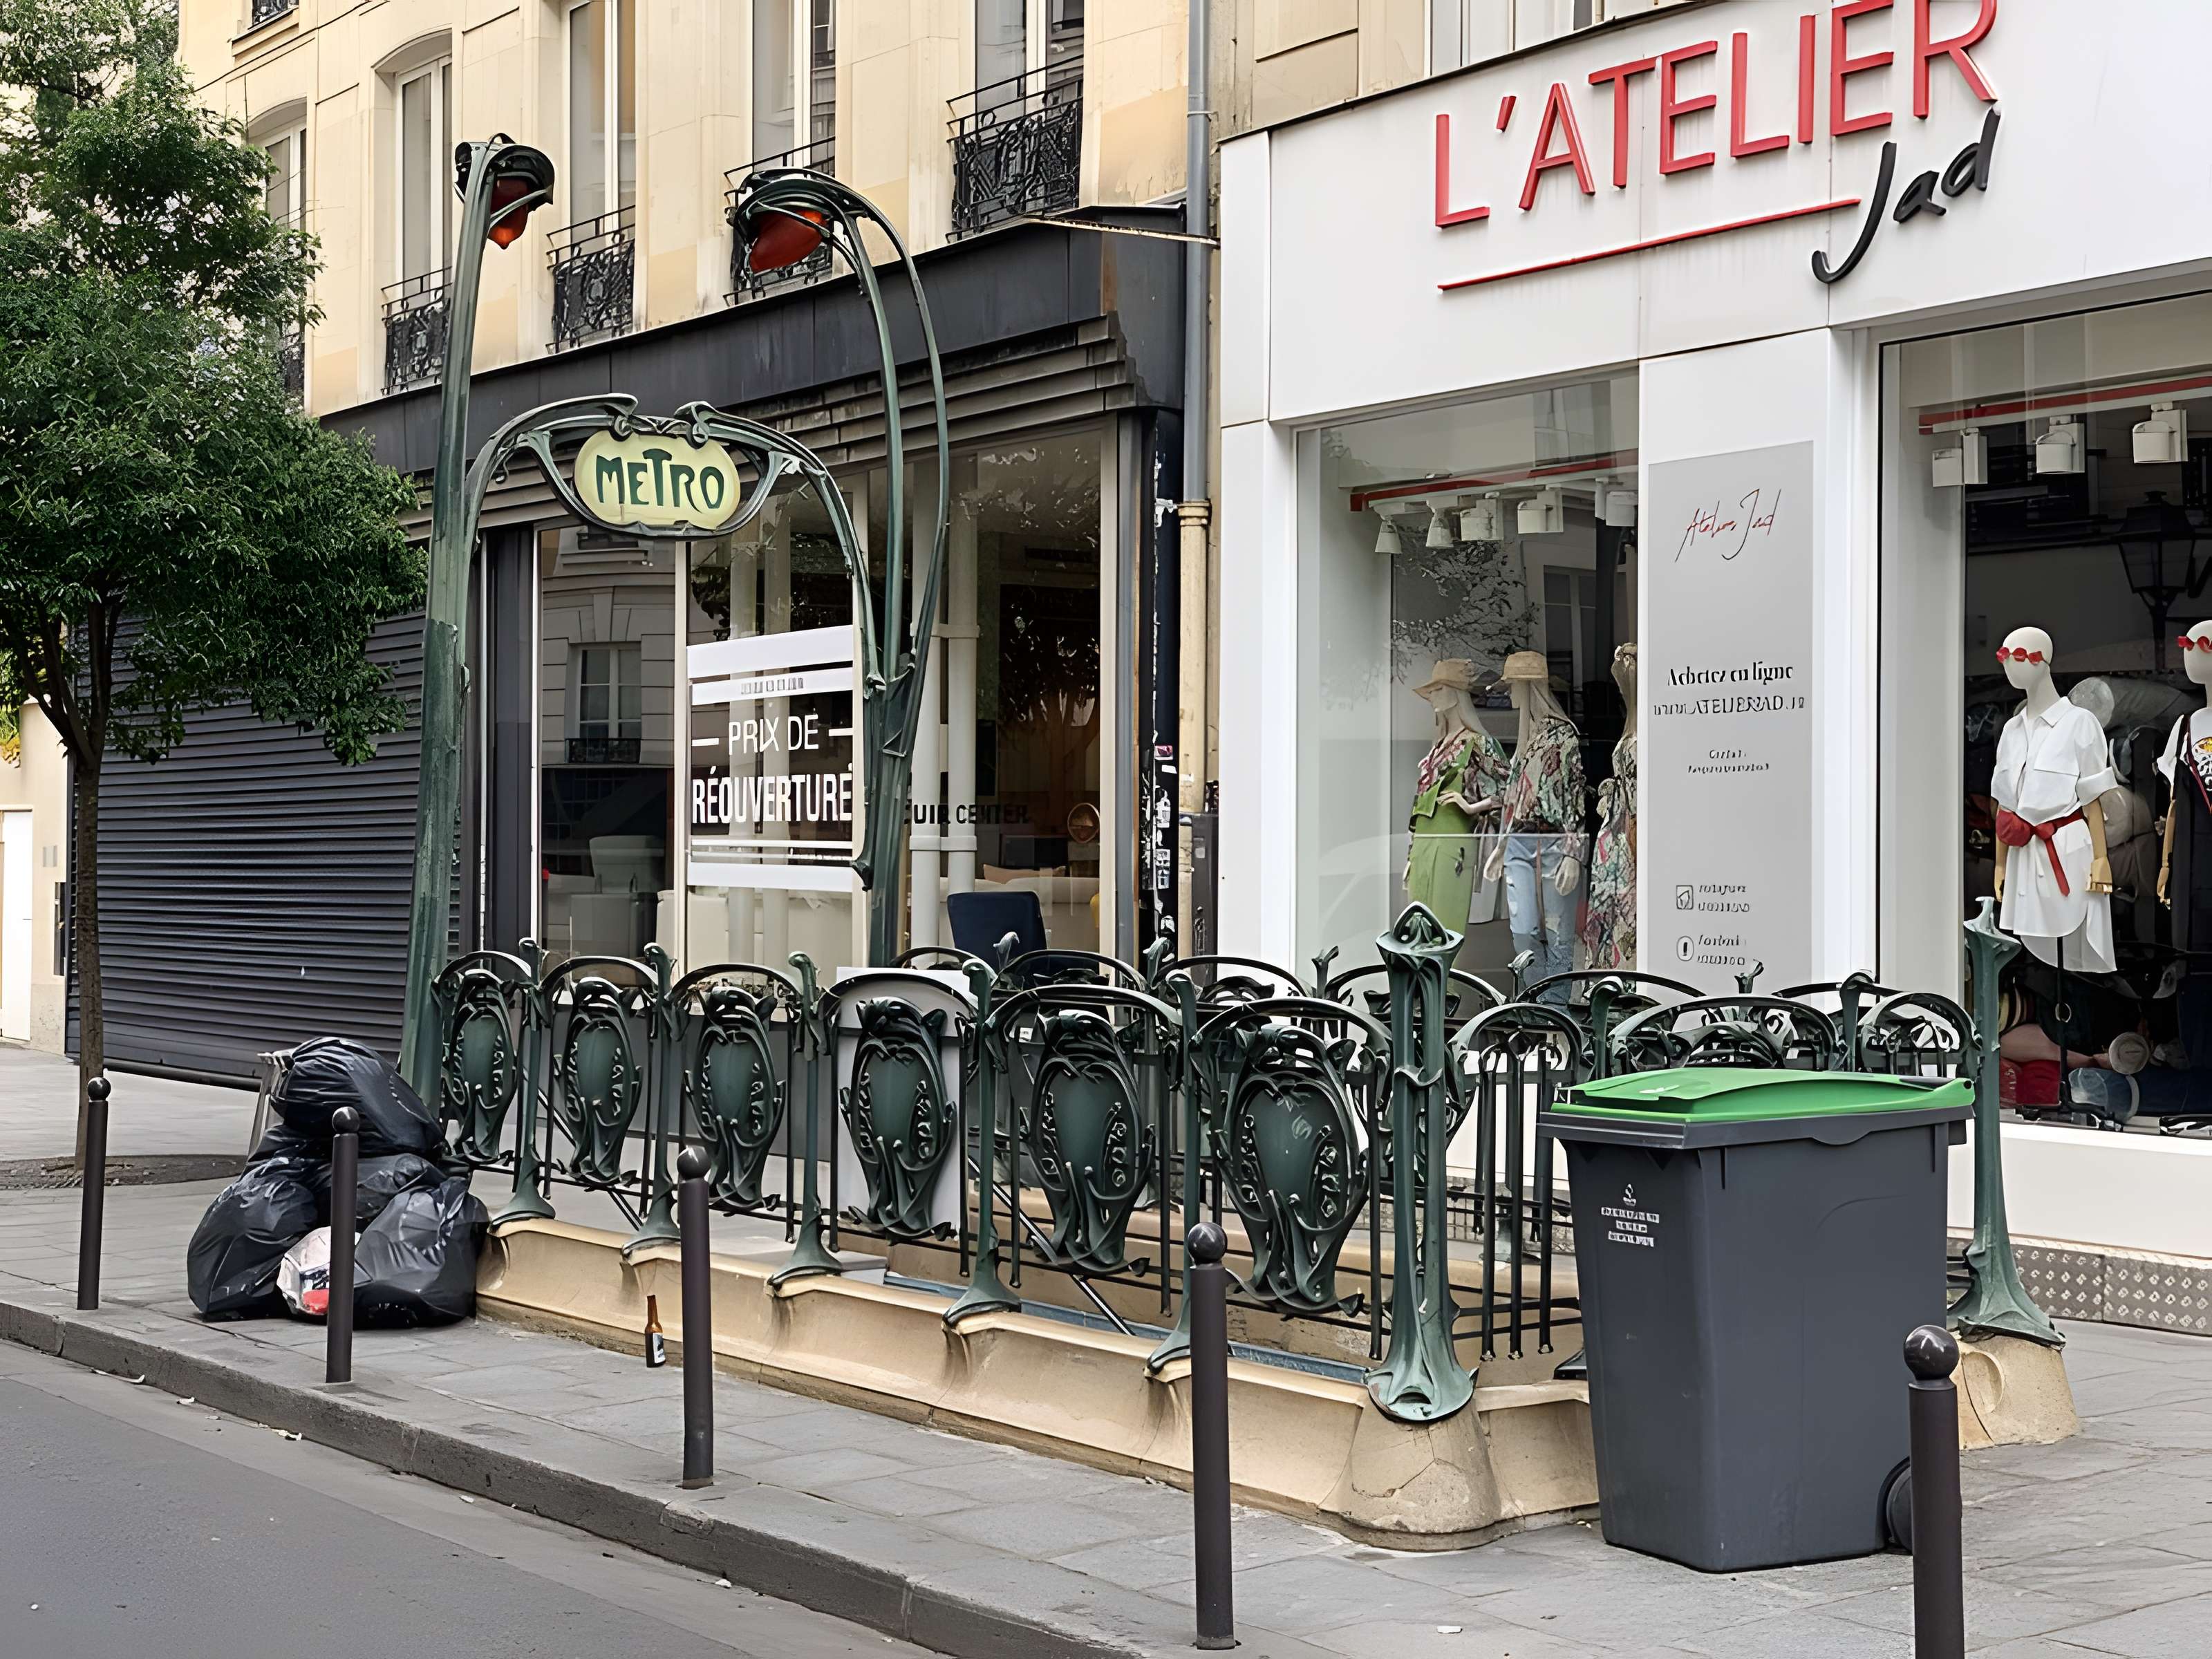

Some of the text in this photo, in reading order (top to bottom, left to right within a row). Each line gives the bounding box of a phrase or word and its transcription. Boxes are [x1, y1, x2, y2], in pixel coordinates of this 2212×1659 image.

[1435, 0, 1998, 227] L'ATELIER
[1811, 108, 2002, 284] Jad
[595, 448, 724, 513] METRO
[729, 716, 780, 756] PRIX
[905, 804, 950, 824] UIR
